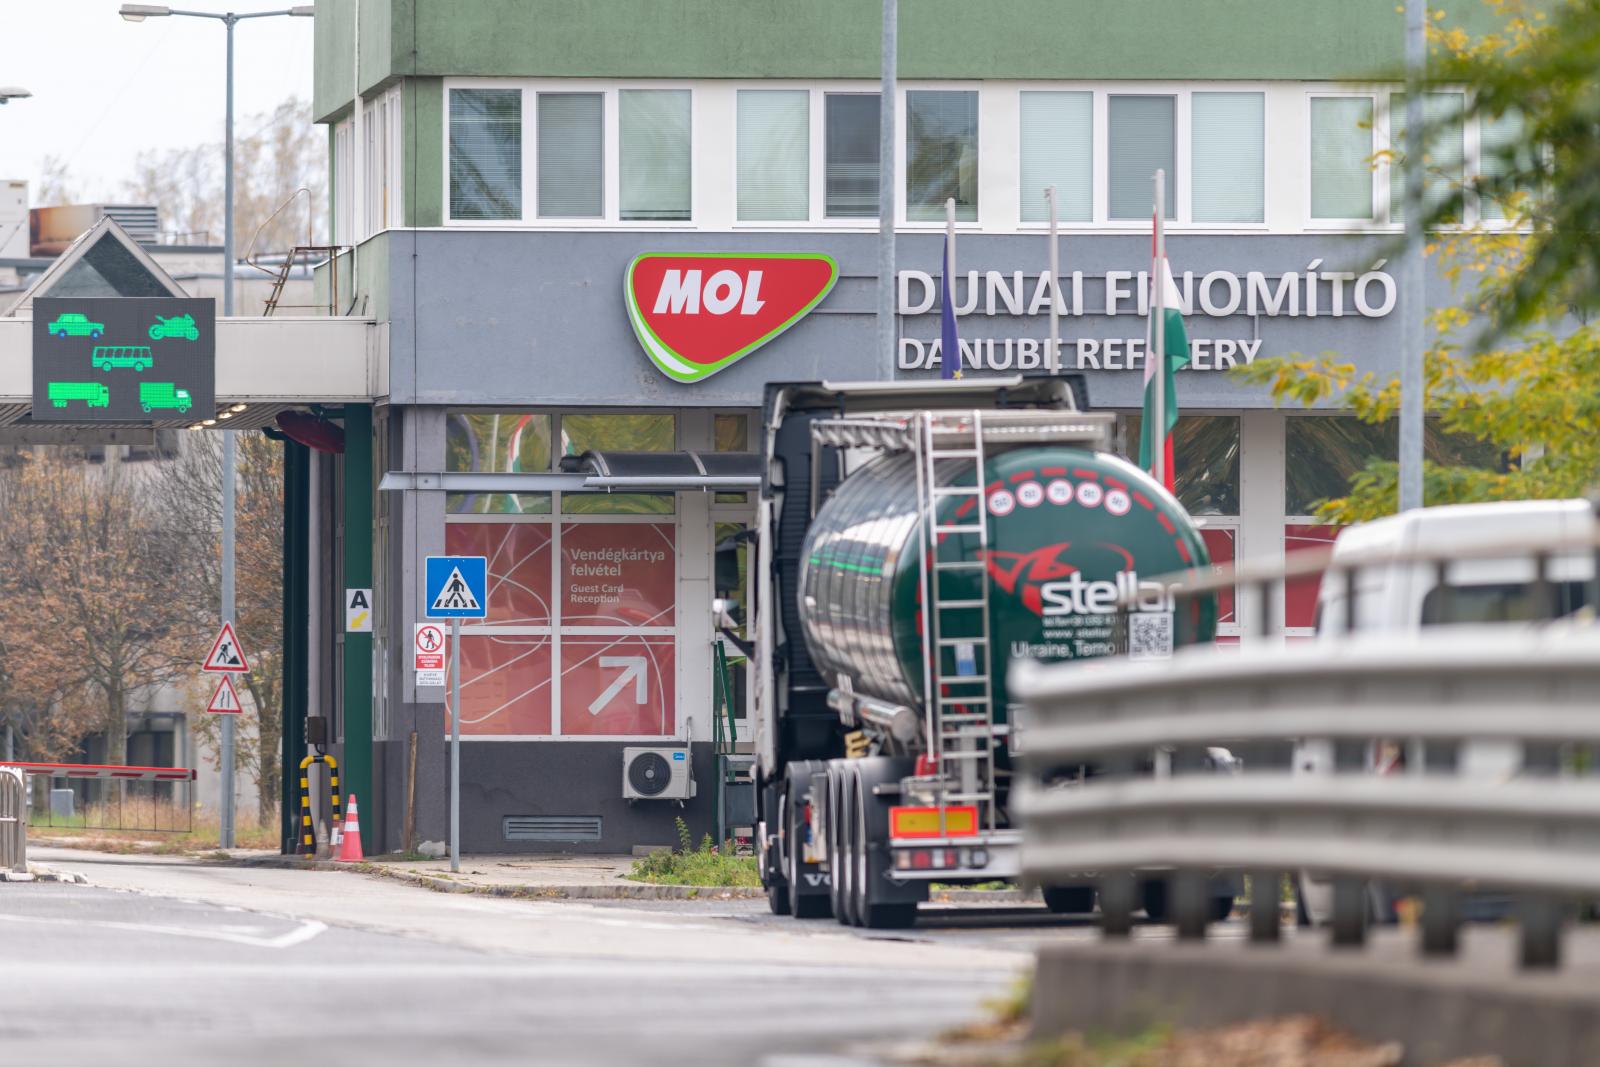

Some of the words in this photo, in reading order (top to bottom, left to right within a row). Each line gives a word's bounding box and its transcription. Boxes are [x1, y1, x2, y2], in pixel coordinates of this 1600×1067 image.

[653, 269, 766, 316] MOL
[898, 271, 1083, 316] DUNAI
[898, 338, 1062, 370] DANUBE
[1077, 338, 1263, 370] REFERY
[569, 547, 665, 563] Vendégkártya
[570, 563, 622, 576] felvétel
[570, 583, 599, 593] Guest
[601, 583, 625, 593] Card
[1041, 570, 1183, 616] stellar
[350, 591, 369, 609] A
[570, 593, 620, 605] Reception
